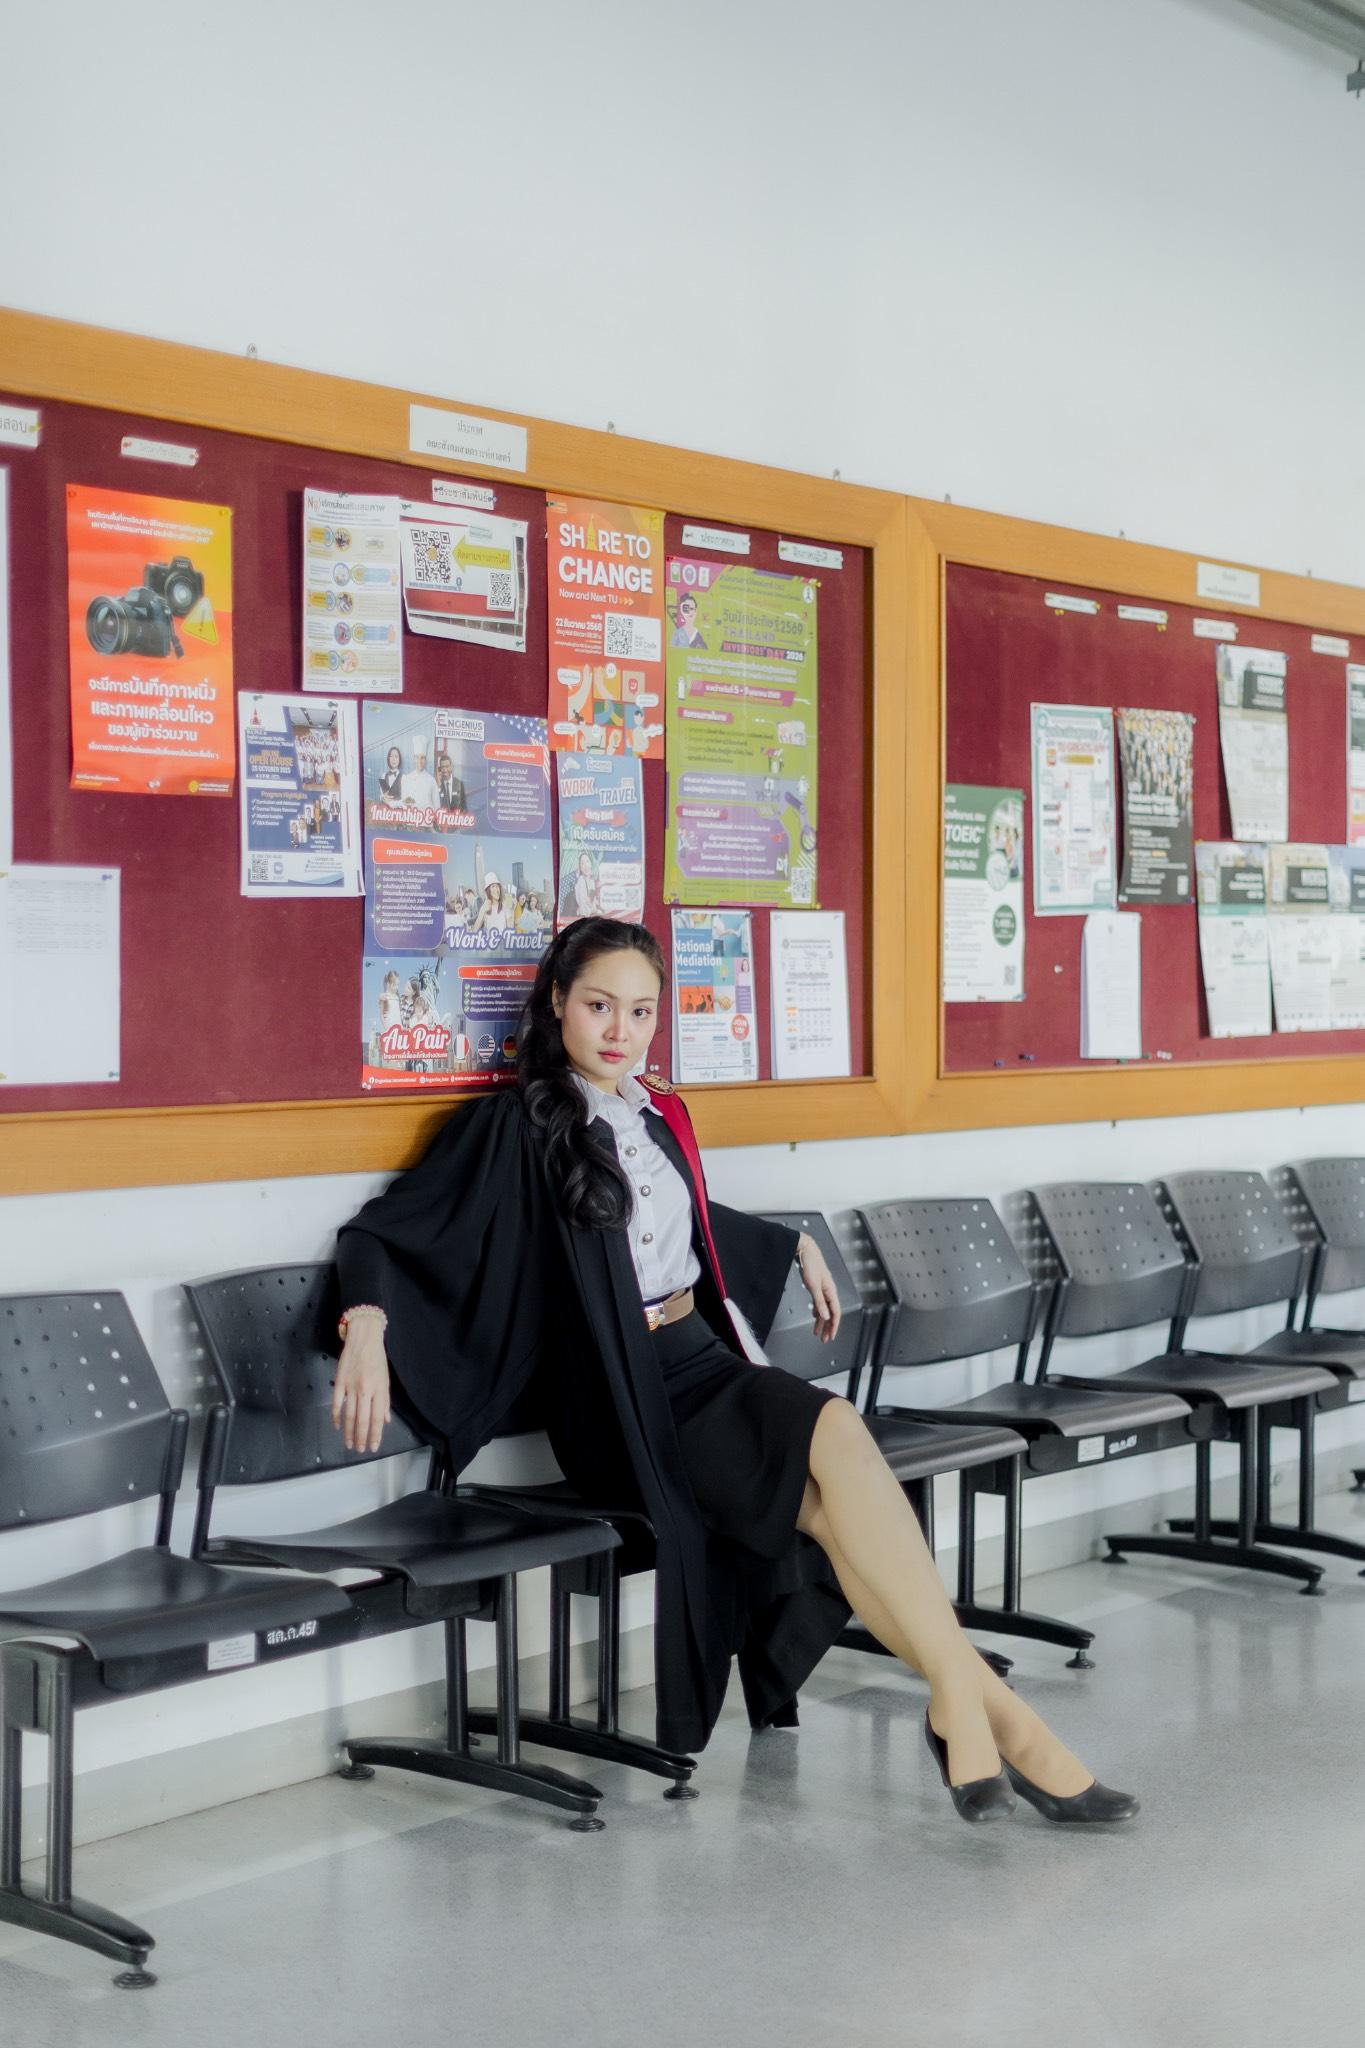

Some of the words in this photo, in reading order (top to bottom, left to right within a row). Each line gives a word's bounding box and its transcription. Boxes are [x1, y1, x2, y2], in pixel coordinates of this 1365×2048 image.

[624, 533, 651, 559] TO
[558, 556, 654, 594] CHANGE
[560, 588, 574, 599] Now
[576, 590, 590, 600] and
[591, 591, 606, 602] Next
[608, 594, 618, 604] TU
[437, 713, 483, 731] ENGENIUS
[437, 729, 483, 740] INTERNATIONAL
[249, 755, 269, 766] OPEN
[272, 757, 294, 767] HOUSE
[561, 779, 593, 797] WORK
[601, 787, 637, 805] TRAVEL
[370, 805, 424, 828] Internship
[424, 810, 434, 824] &
[436, 808, 476, 827] Trainee
[573, 826, 625, 843] เปิดรับสมัคร
[945, 824, 981, 844] TOEIC
[446, 926, 488, 949] Work
[489, 929, 500, 949] &
[503, 930, 544, 950] Travel
[674, 939, 714, 953] National
[674, 953, 722, 967] Mediation
[384, 1028, 410, 1053] Au
[412, 1026, 451, 1050] Pair
